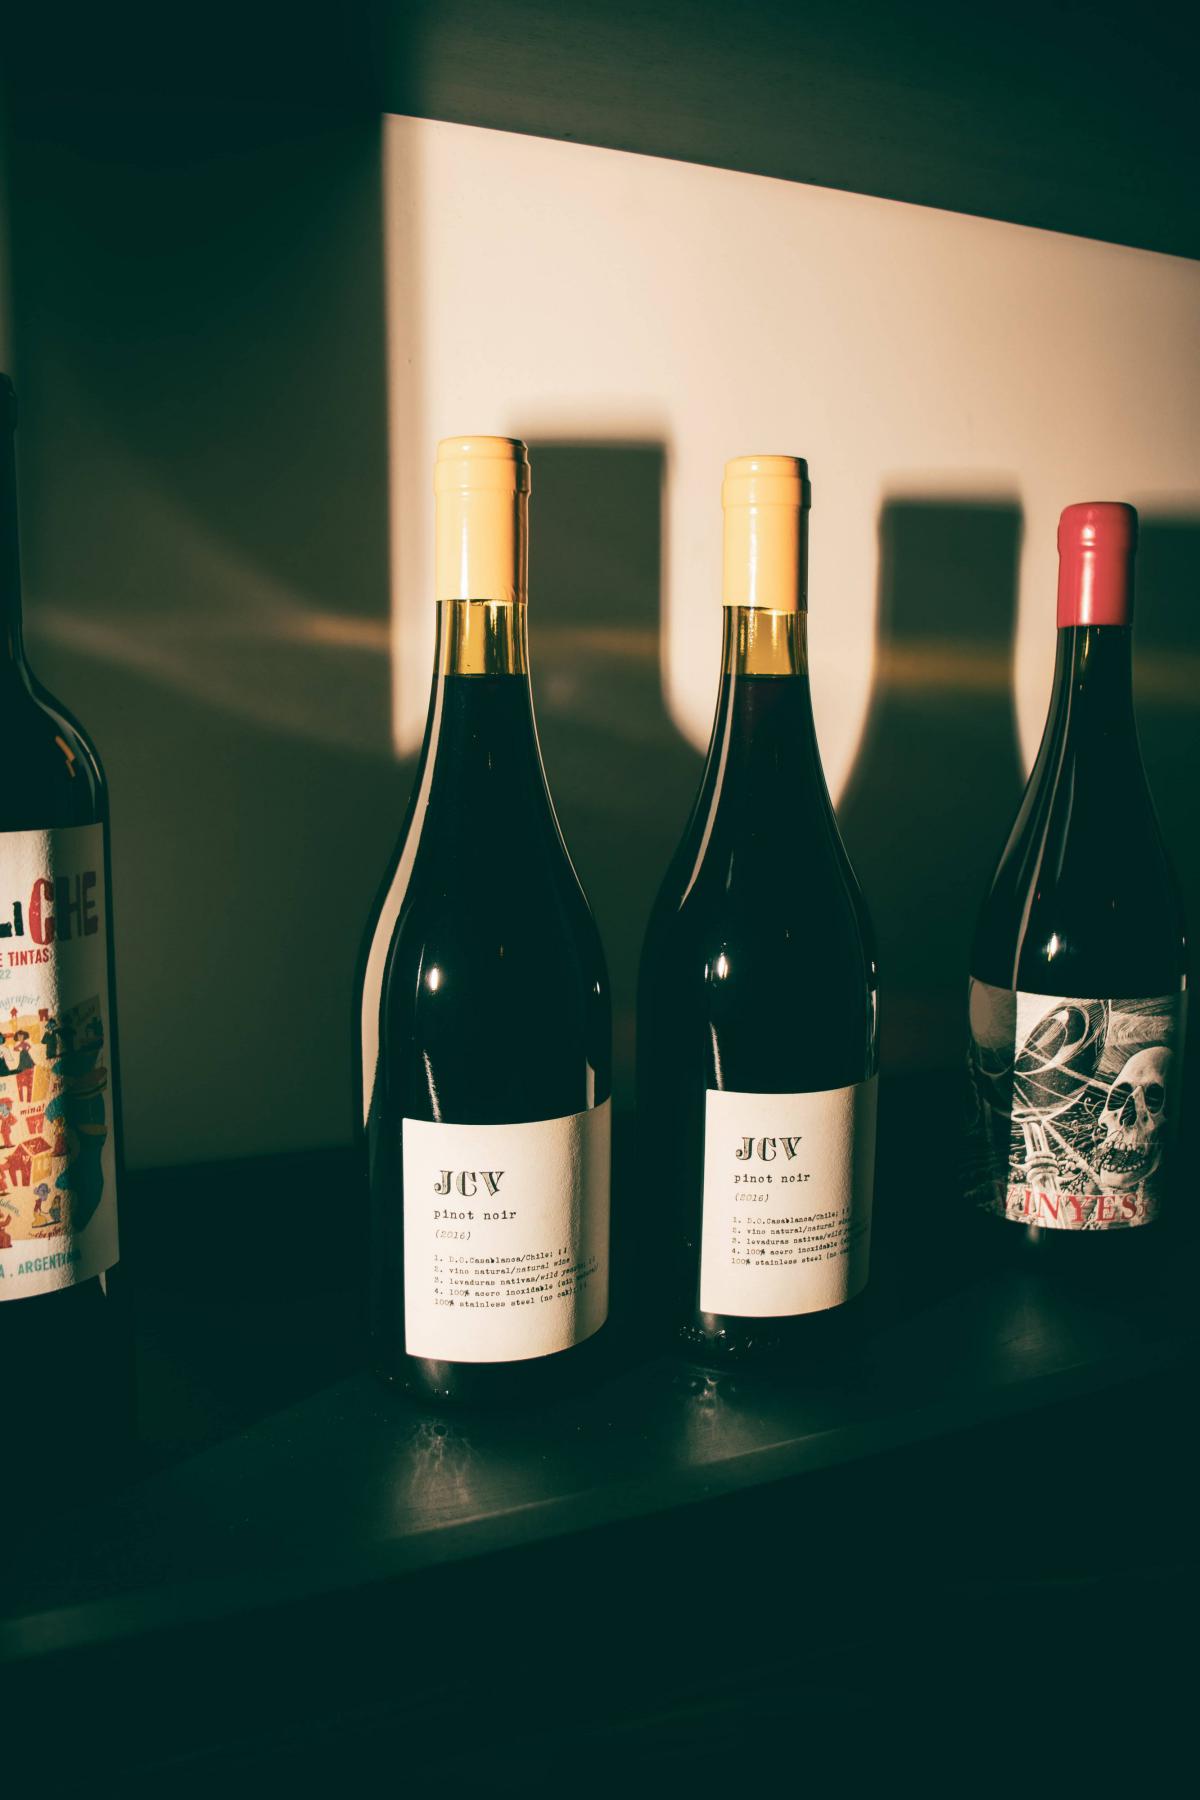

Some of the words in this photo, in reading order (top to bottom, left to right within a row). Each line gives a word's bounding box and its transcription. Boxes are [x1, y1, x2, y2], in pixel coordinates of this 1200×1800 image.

[8, 948, 50, 967] TINTAS
[735, 1136, 802, 1161] JCV
[434, 1170, 505, 1196] JCV
[734, 1174, 773, 1184] pinot
[781, 1173, 810, 1183] noir
[434, 1209, 474, 1220] pinot
[484, 1210, 516, 1220] noir
[435, 1229, 471, 1241] (2016)
[17, 1249, 80, 1275] ARGENTI
[434, 1254, 443, 1262] 1.
[434, 1288, 443, 1296] 4.
[460, 1299, 506, 1308] stainless
